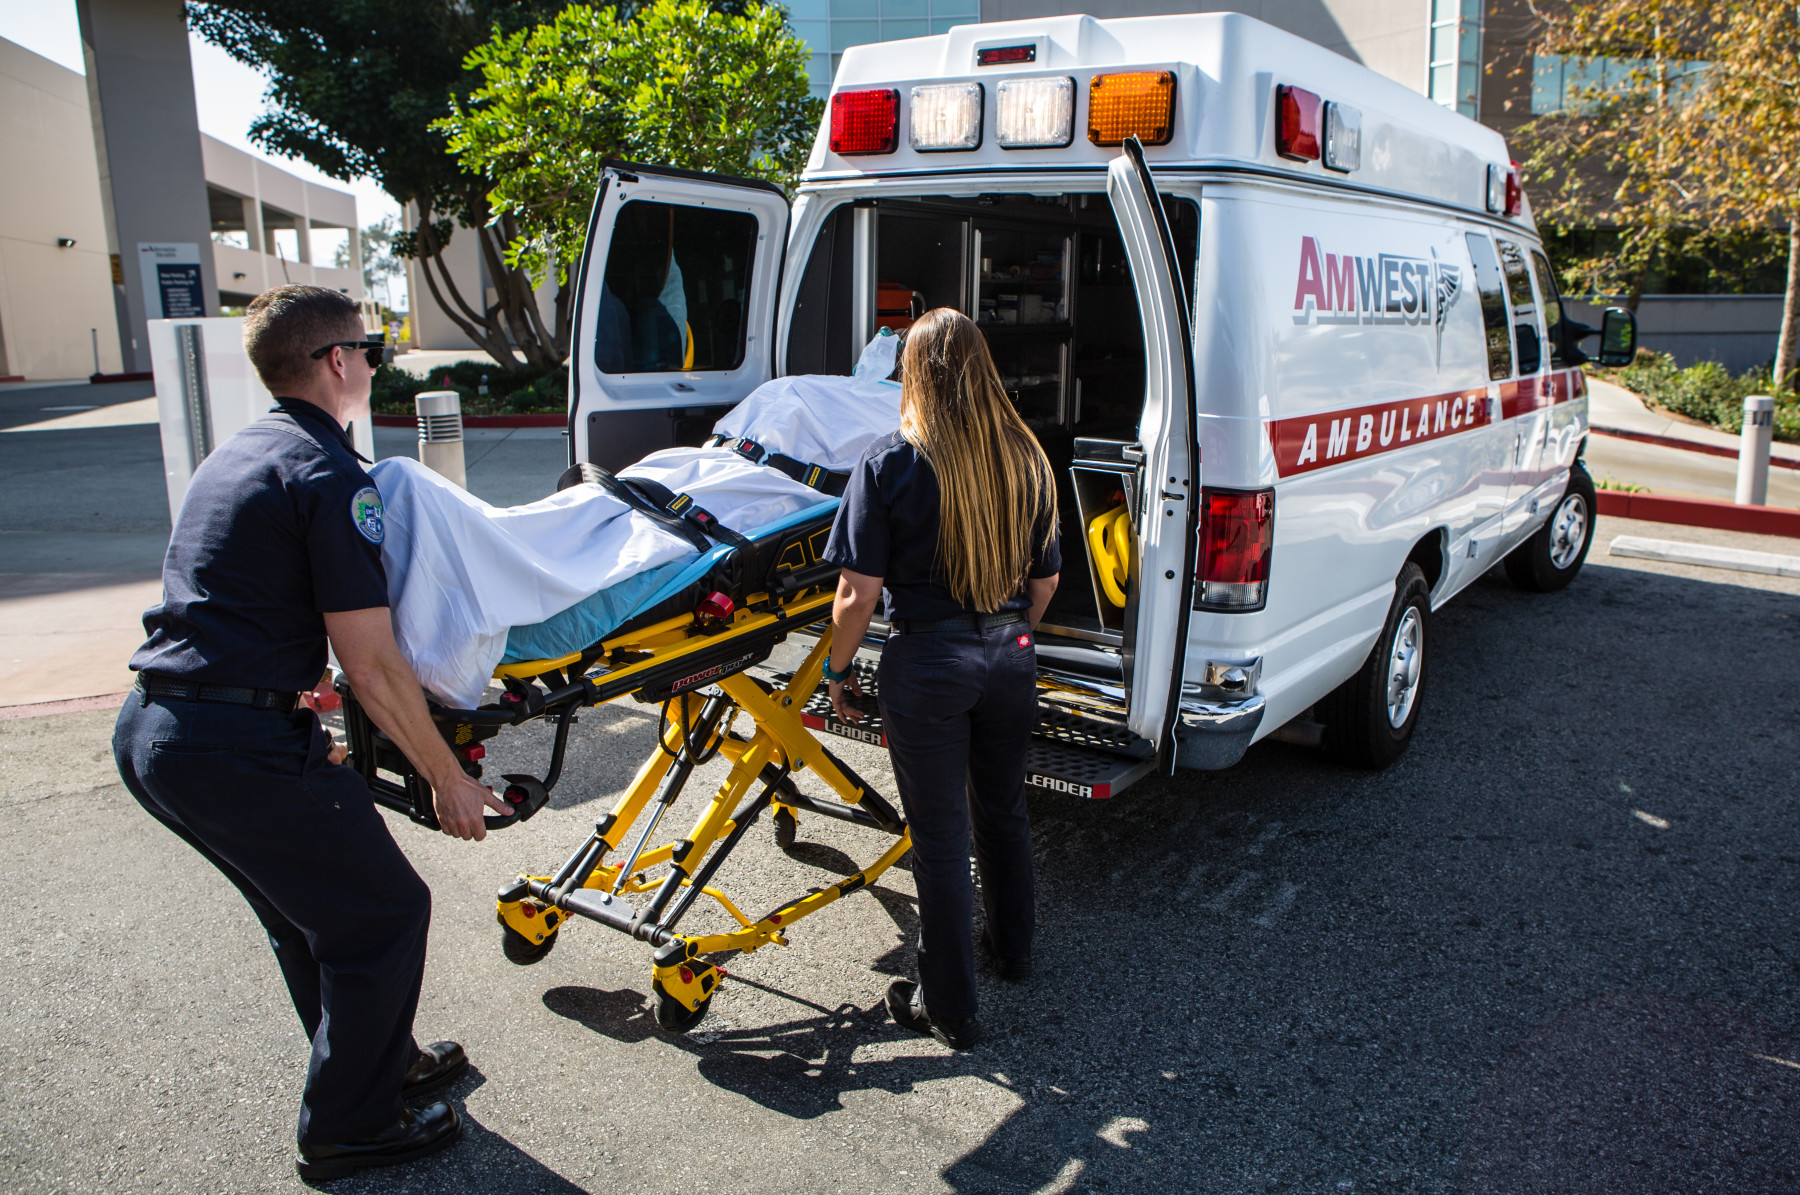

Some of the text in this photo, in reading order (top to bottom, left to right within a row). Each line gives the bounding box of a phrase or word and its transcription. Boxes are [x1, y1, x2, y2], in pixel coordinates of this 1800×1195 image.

[1293, 235, 1432, 322] AMWEST
[1296, 394, 1477, 466] AMBULANCE
[824, 719, 882, 745] LEADER
[1024, 772, 1093, 798] LEADER
